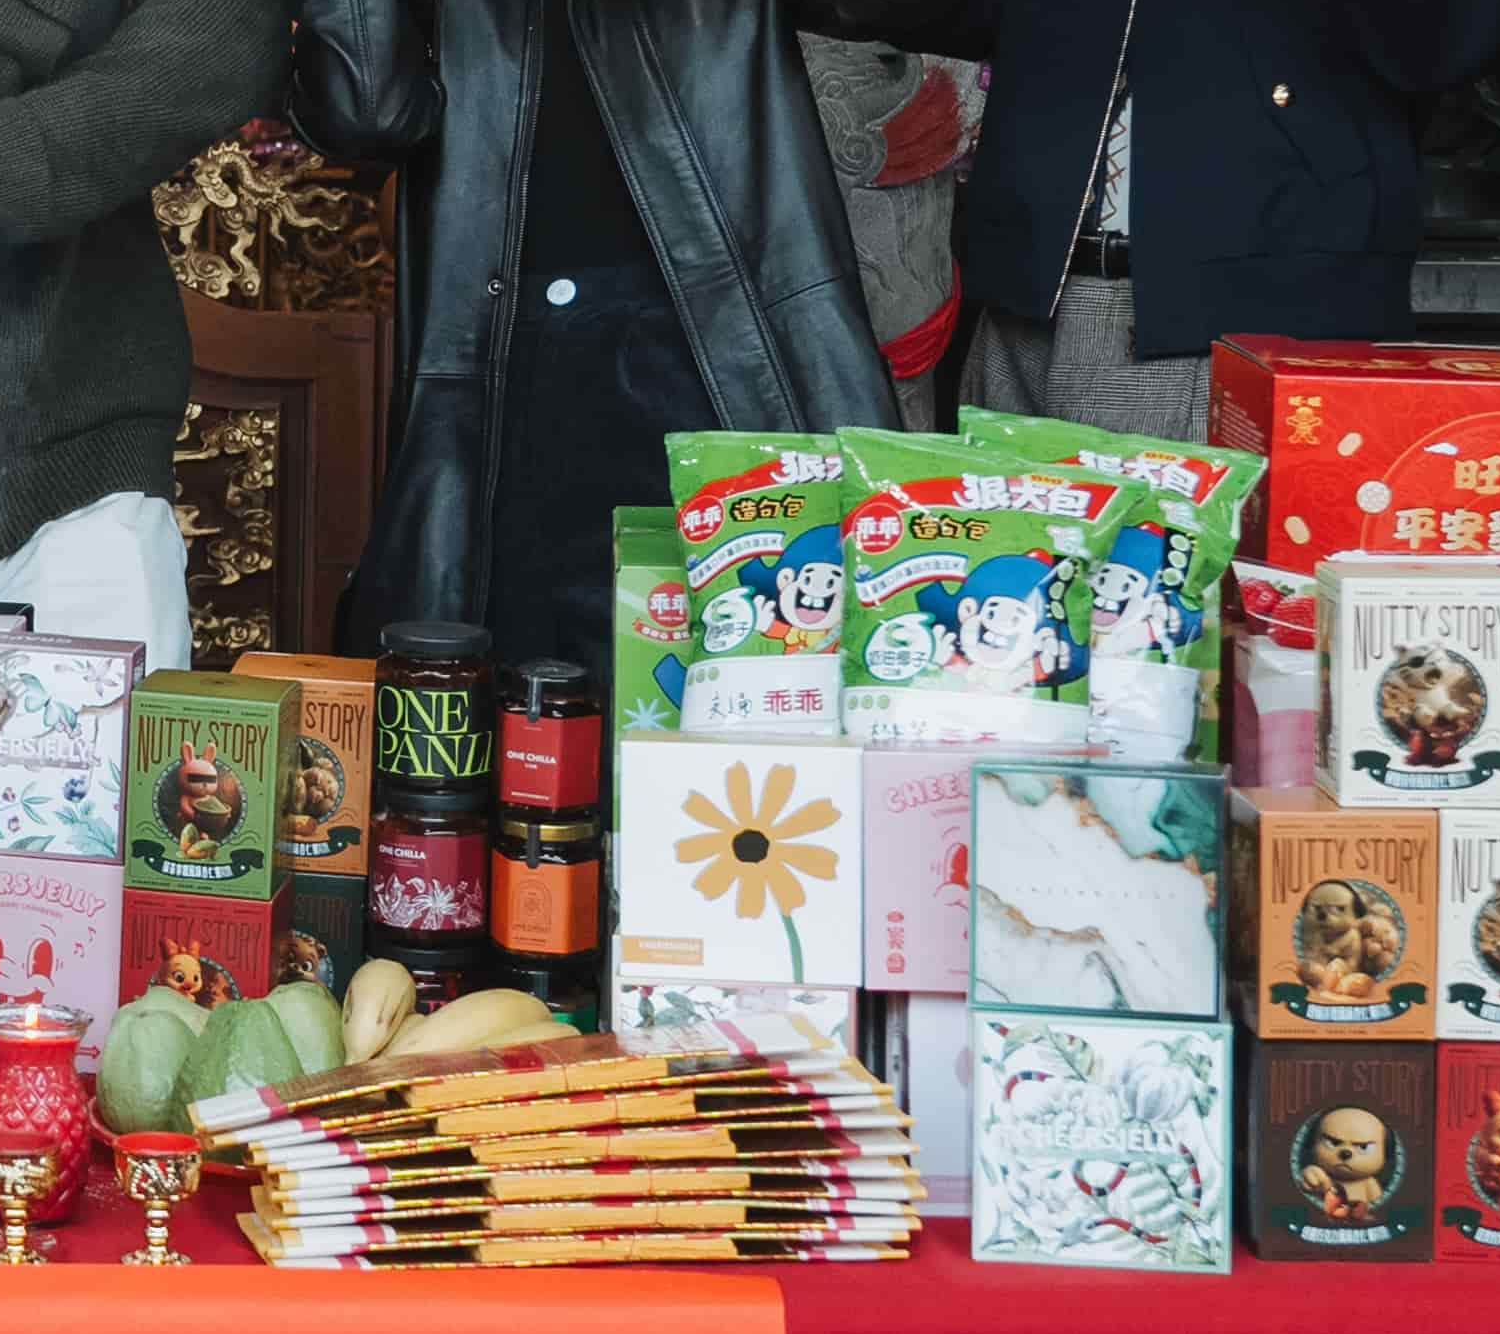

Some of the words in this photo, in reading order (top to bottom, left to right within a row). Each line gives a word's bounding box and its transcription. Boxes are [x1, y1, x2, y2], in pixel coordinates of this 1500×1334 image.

[730, 495, 806, 522] 造句包
[955, 473, 1089, 517] 狠大包
[854, 516, 901, 540] 乖乖
[909, 515, 992, 542] 造句包
[1352, 603, 1430, 671] NUTTY
[304, 701, 368, 758] STORY
[377, 685, 469, 734] ONE
[137, 715, 202, 774] NUTTY
[207, 721, 272, 783] STORY
[1270, 837, 1350, 904] NUTTY
[1355, 838, 1428, 909] STORY
